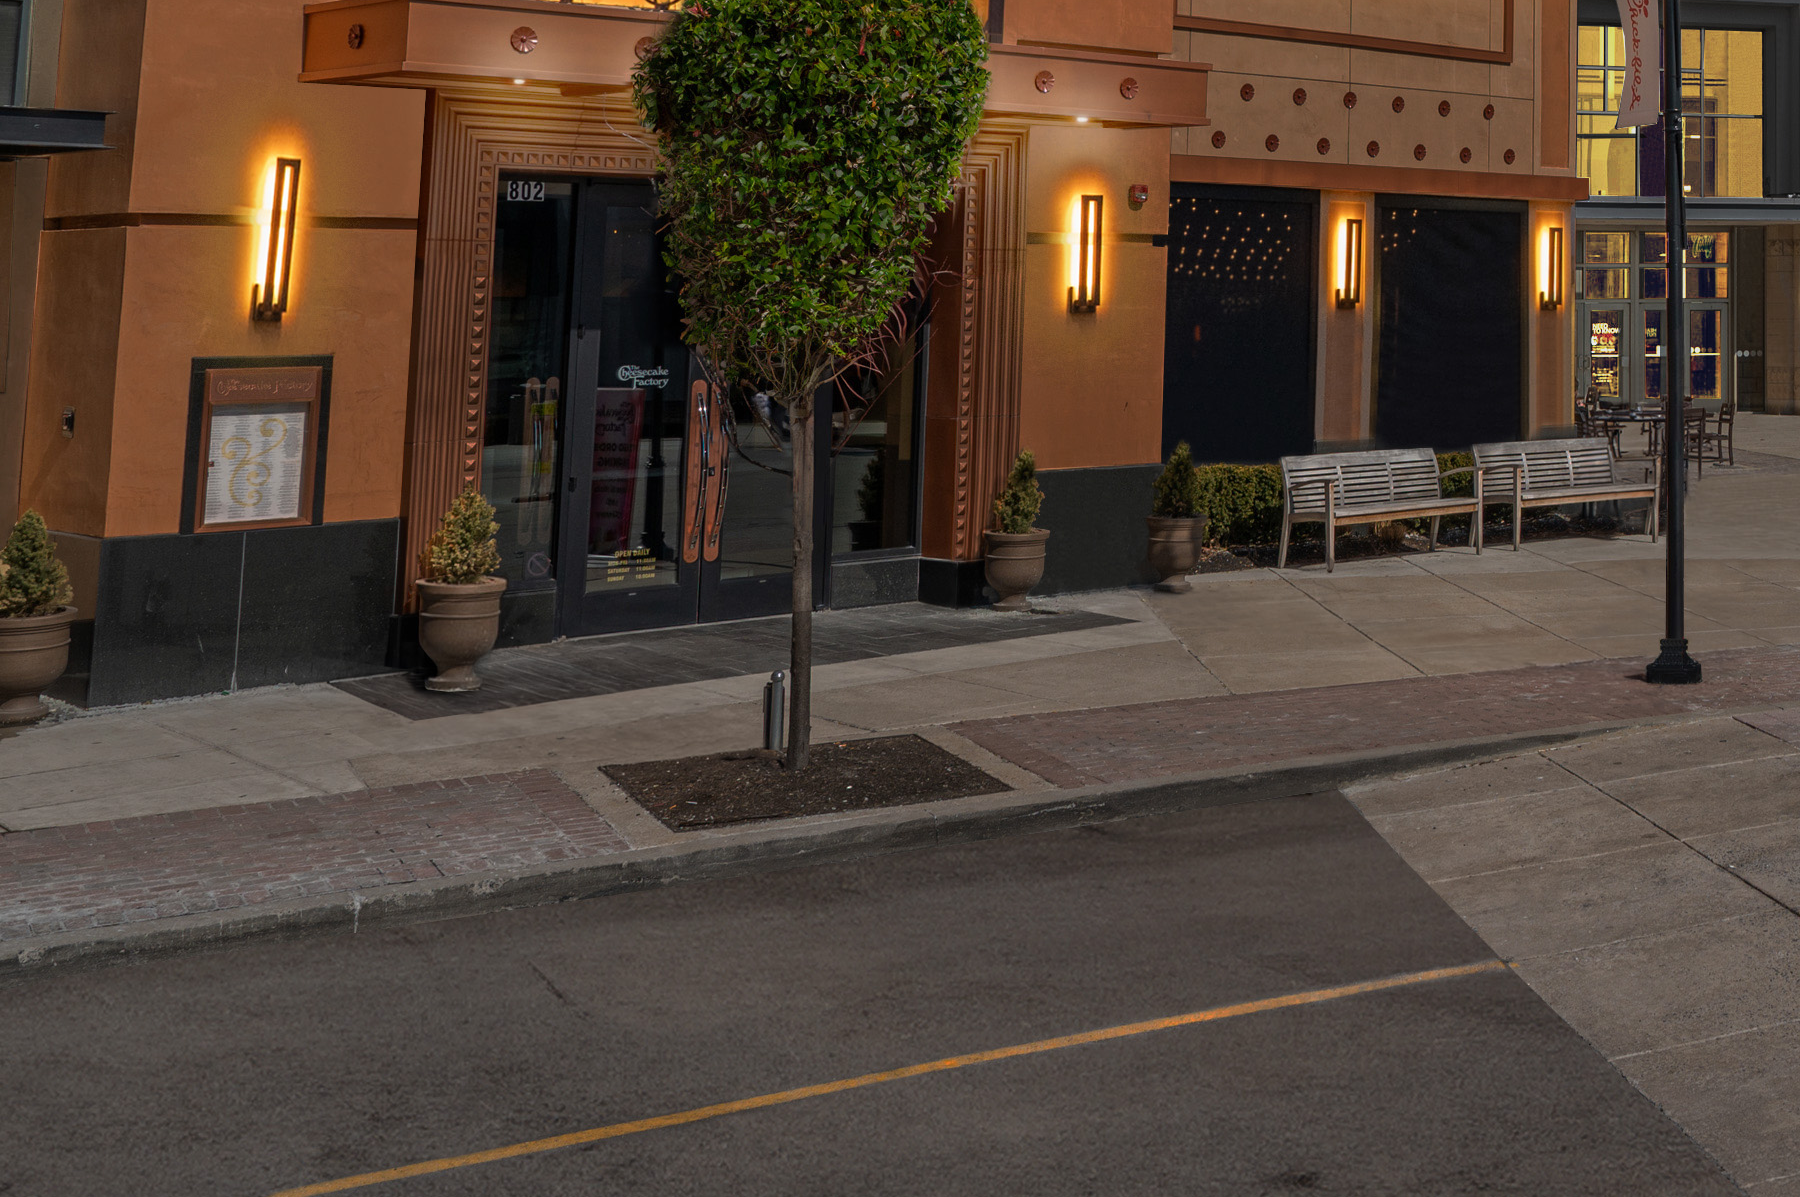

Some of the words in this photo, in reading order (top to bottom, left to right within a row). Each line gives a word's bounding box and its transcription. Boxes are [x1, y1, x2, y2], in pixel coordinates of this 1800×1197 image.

[509, 181, 544, 201] 802
[1592, 322, 1609, 331] NEED
[618, 365, 670, 381] Cheesecake
[629, 375, 670, 390] Factory
[615, 550, 632, 558] OPEN
[633, 548, 651, 556] DAILY
